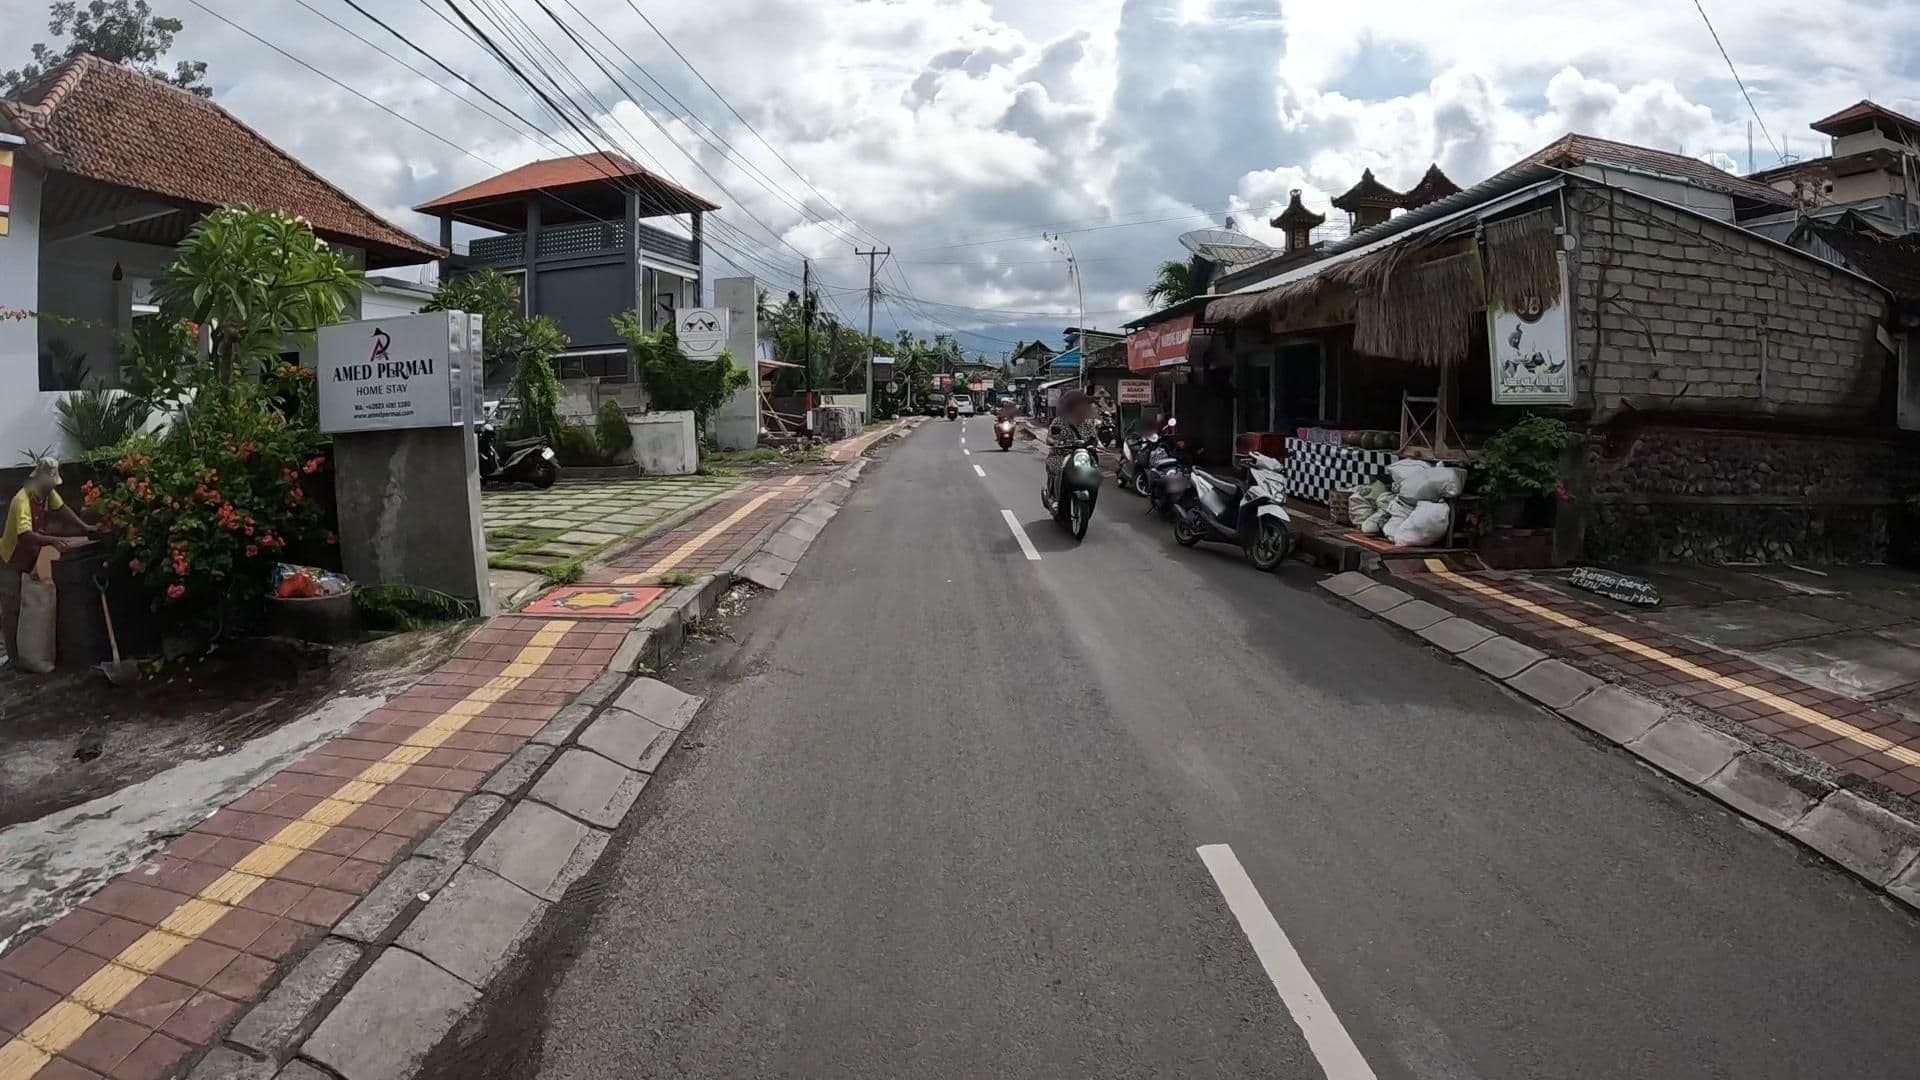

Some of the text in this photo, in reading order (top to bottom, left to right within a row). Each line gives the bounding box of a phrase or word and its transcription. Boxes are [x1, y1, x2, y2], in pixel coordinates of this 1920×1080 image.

[333, 359, 433, 382] AMED PERMAI
[356, 384, 408, 396] HOME STAY
